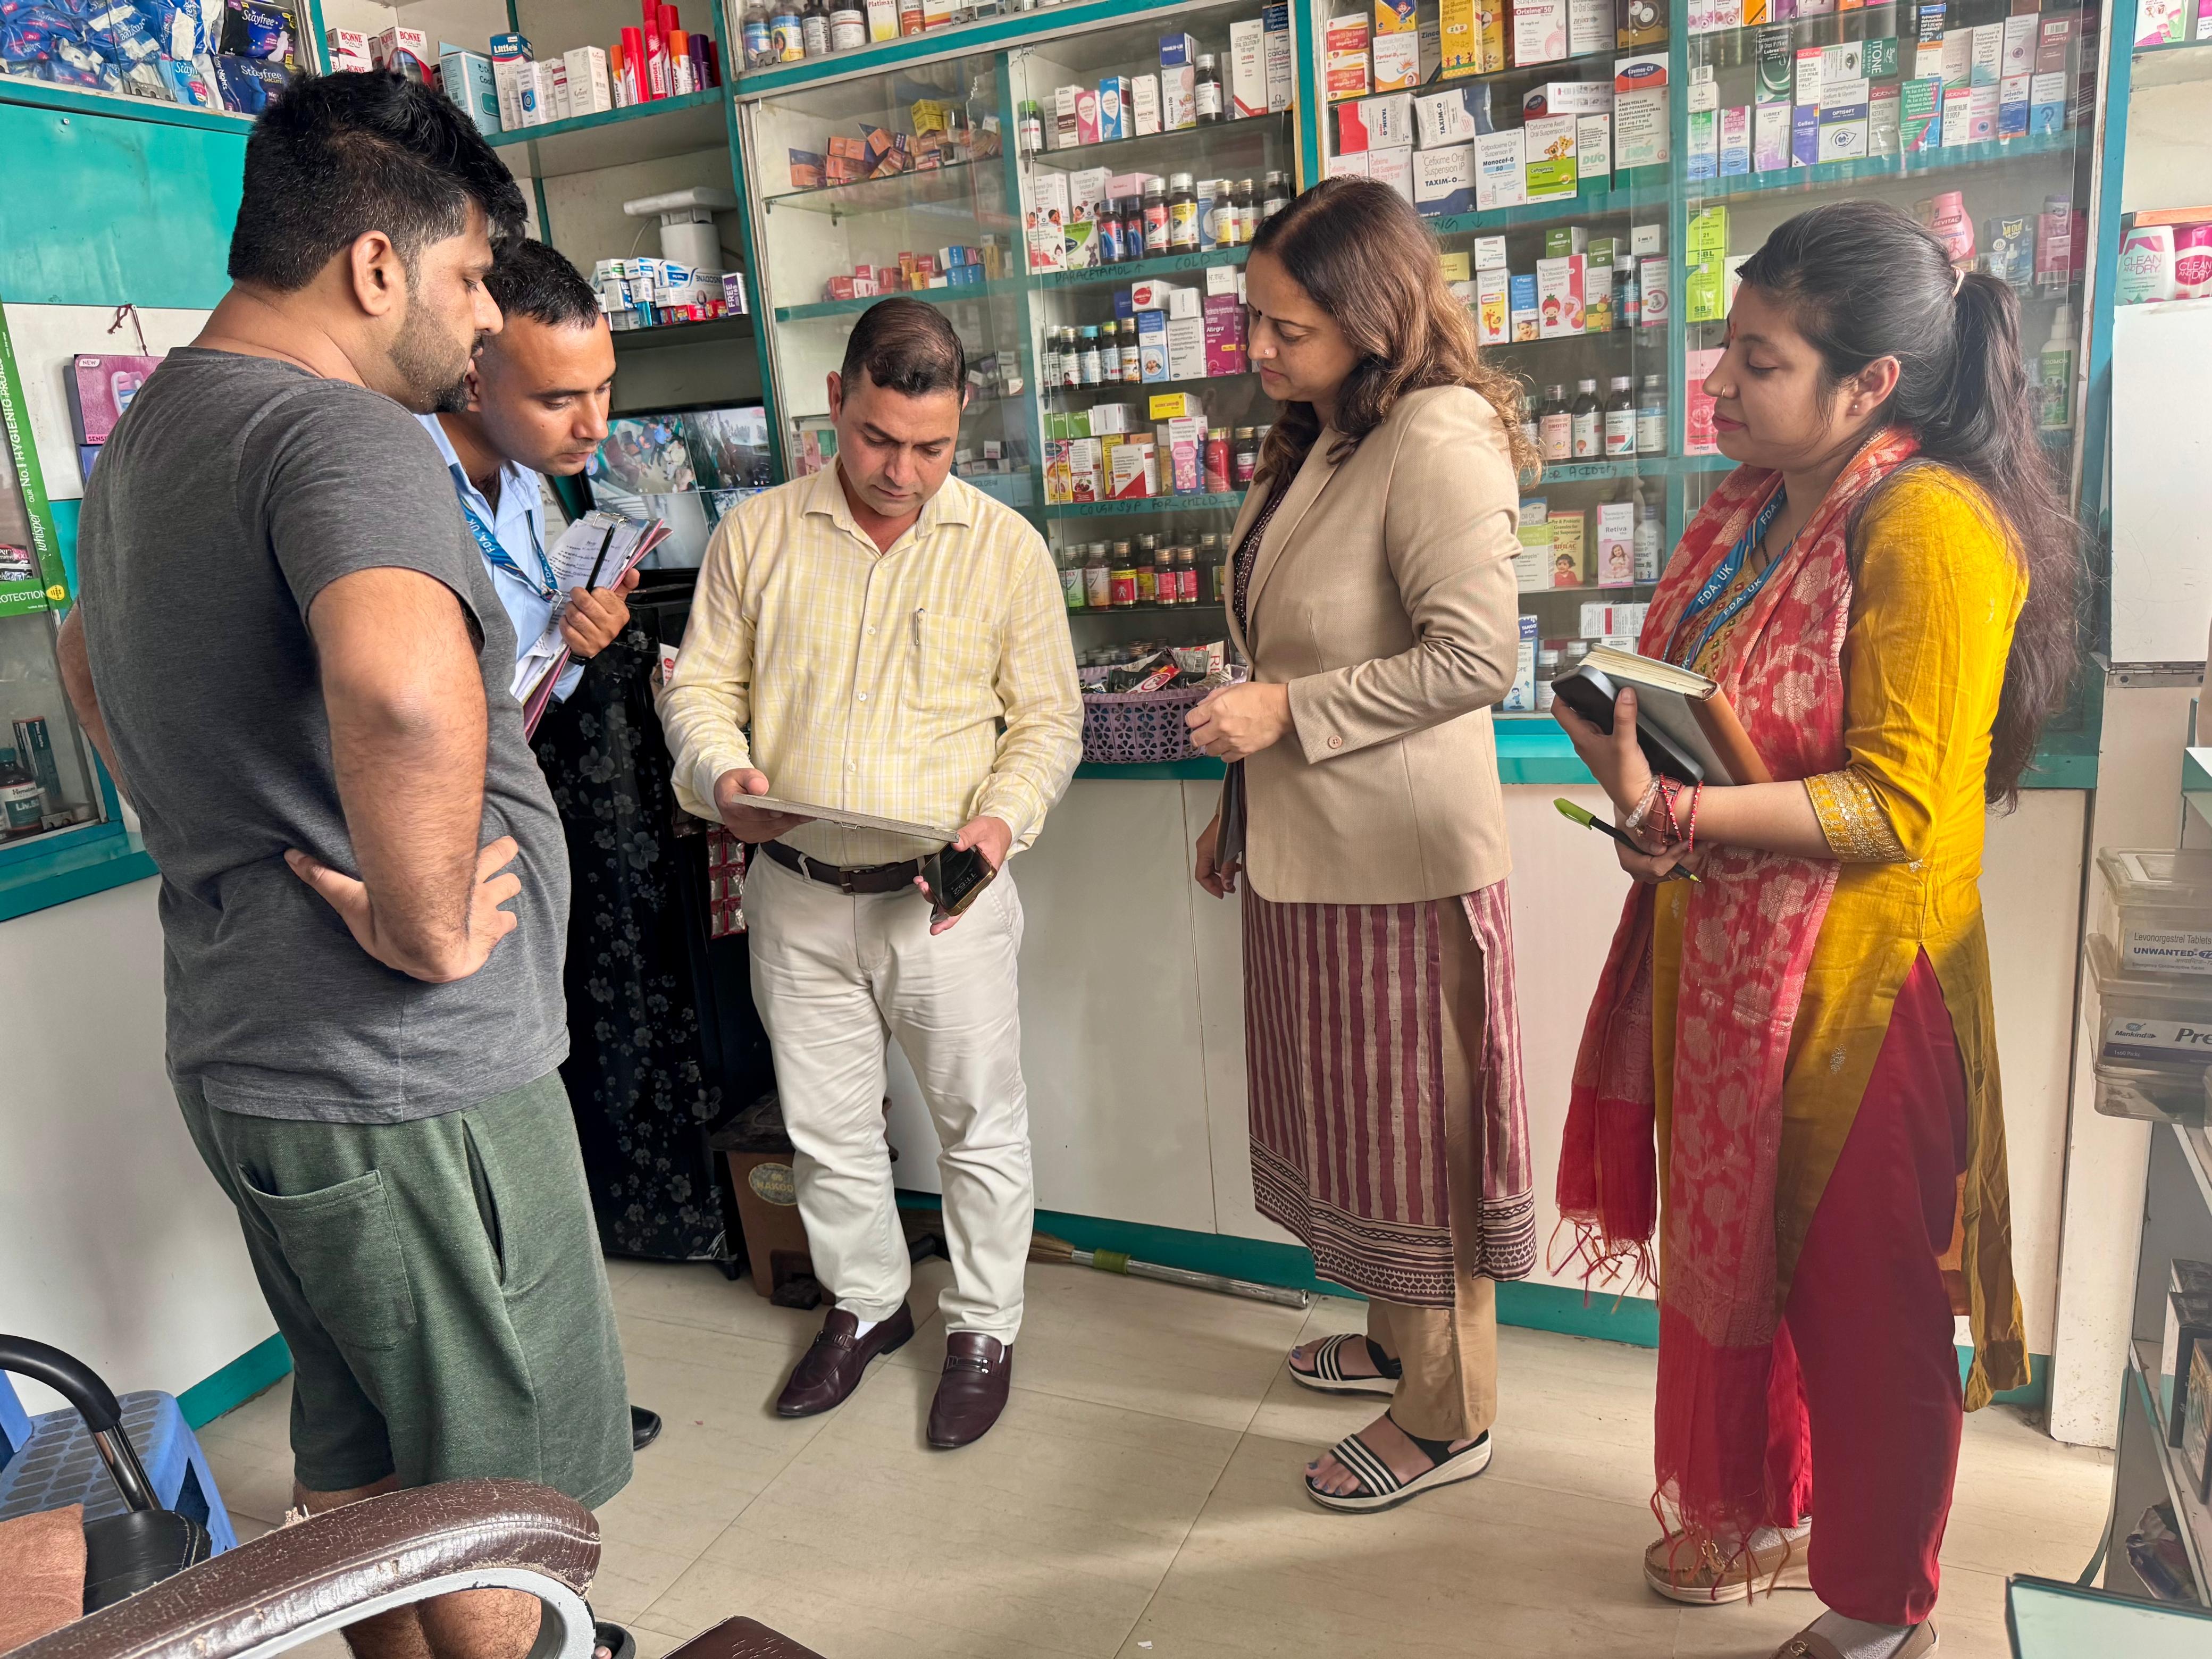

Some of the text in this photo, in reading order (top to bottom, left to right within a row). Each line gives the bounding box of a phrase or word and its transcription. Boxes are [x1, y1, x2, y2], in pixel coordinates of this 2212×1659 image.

[242, 10, 275, 26] Stayfree
[340, 31, 363, 43] BONNE
[400, 31, 421, 42] BONNE
[1421, 30, 1439, 39] Zinco
[241, 65, 282, 79] Stayfree
[1437, 103, 1446, 135] TAXIM-O
[1530, 122, 1553, 131] Cefuroxime
[1539, 128, 1564, 137] Suspension
[1423, 153, 1465, 166] Cefixime Oral
[1483, 157, 1514, 166] Monocef-O
[1582, 154, 1606, 165] DUO
[1380, 164, 1401, 174] Suspension
[1425, 165, 1457, 177] Suspension
[1425, 177, 1457, 186] TAXIM-O
[1933, 216, 1960, 226] REVITAL
[1176, 256, 1211, 271] COLD
[2124, 254, 2161, 266] CLEAN
[2179, 261, 2212, 271] CLEAN
[1055, 265, 1133, 285] PARACETAMOL
[2136, 264, 2160, 275] DRY
[2192, 271, 2210, 279] DRY
[725, 283, 735, 308] FREE
[1760, 502, 1779, 525] FDA,
[31, 513, 47, 552] whisper
[466, 518, 496, 553] FDA, UK
[544, 564, 554, 583] FDA,
[1698, 564, 1733, 605] FDA, UK
[1723, 579, 1762, 615] FDA, UK
[2134, 933, 2212, 945] Levonorgestrel Tablets
[2175, 1028, 2212, 1045] Pre
